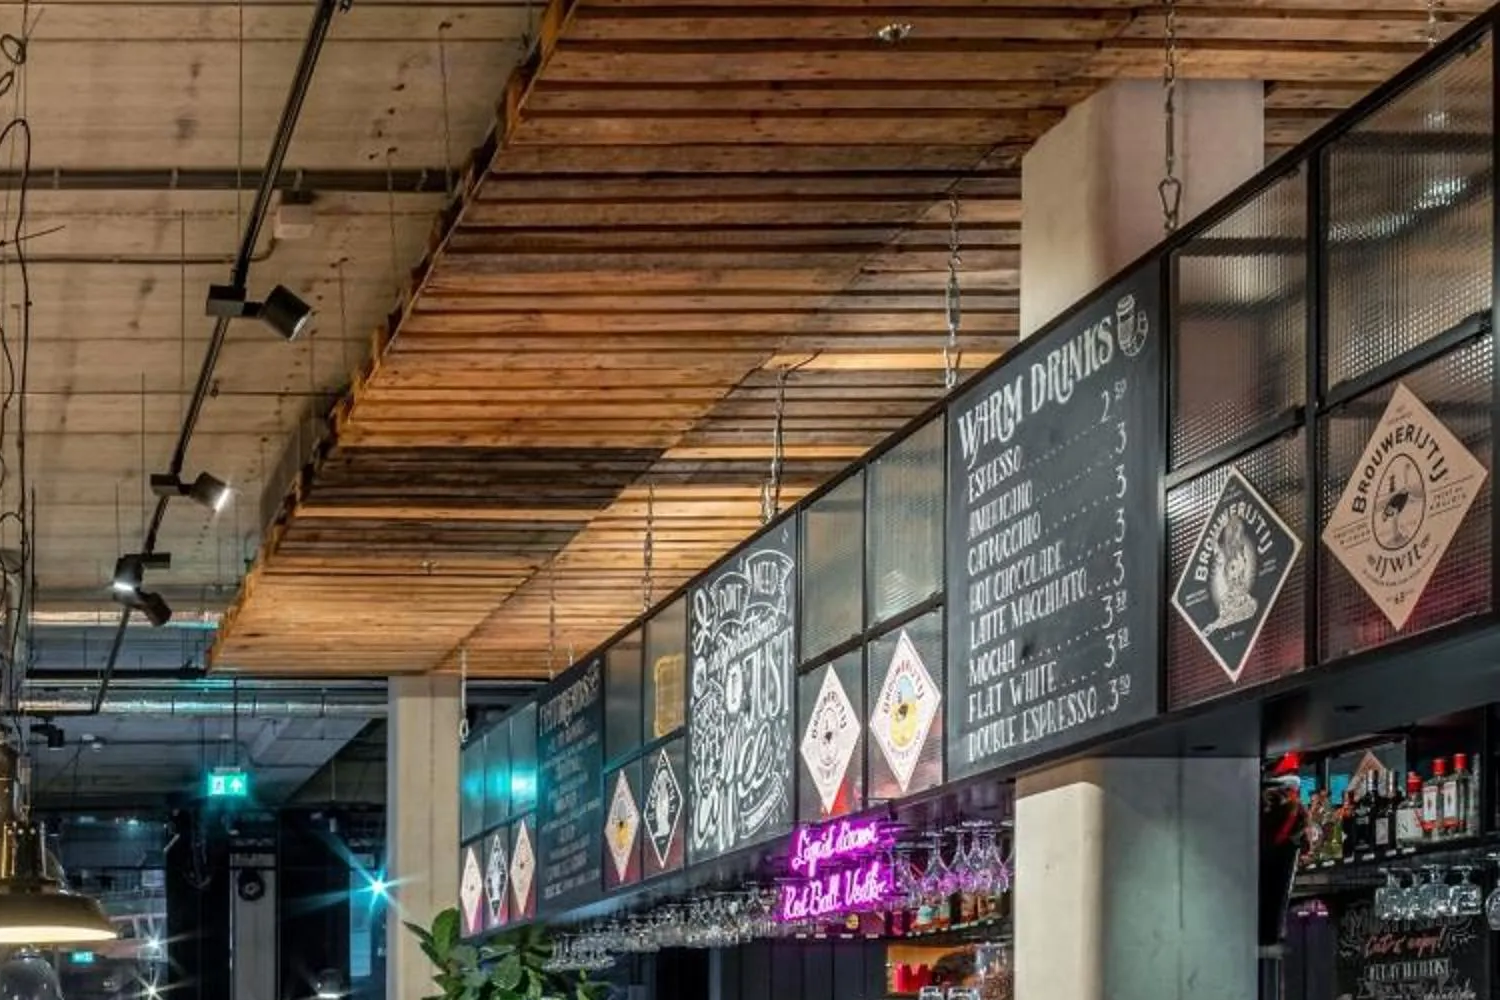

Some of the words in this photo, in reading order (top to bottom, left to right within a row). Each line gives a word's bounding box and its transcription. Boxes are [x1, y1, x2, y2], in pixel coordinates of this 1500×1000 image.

[957, 374, 1024, 471] WARM
[1030, 315, 1114, 415] DRINKS
[1115, 421, 1127, 454] 3
[1115, 463, 1127, 499] 3
[1114, 508, 1126, 543] 3
[971, 603, 1008, 650] LATTE
[1011, 567, 1088, 629] MACCHIATO
[1113, 550, 1125, 586] 3
[968, 638, 1017, 687] MOCHA
[968, 683, 1003, 724] FLAT
[1009, 661, 1058, 706] WHITE
[968, 716, 1018, 762] DOUBLE
[1022, 685, 1098, 744] ESPRESSO
